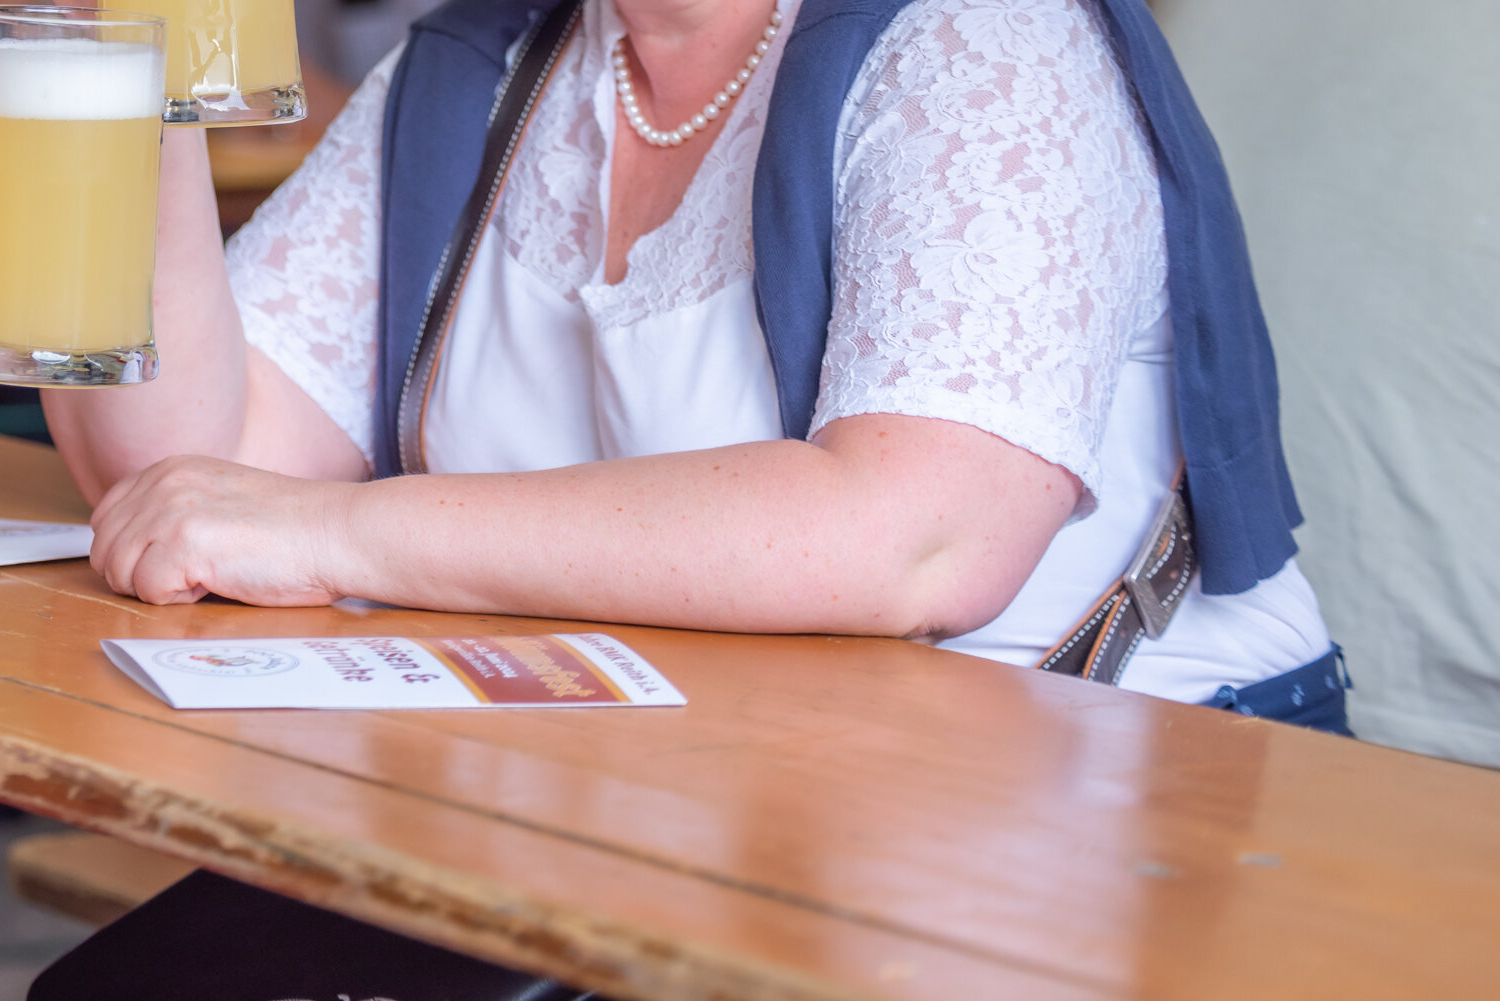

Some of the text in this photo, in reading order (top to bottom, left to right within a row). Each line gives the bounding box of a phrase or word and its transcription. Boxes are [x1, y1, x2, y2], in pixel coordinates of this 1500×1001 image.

[302, 641, 375, 682] Getränke
[350, 639, 421, 670] Speisen
[401, 673, 441, 684] &
